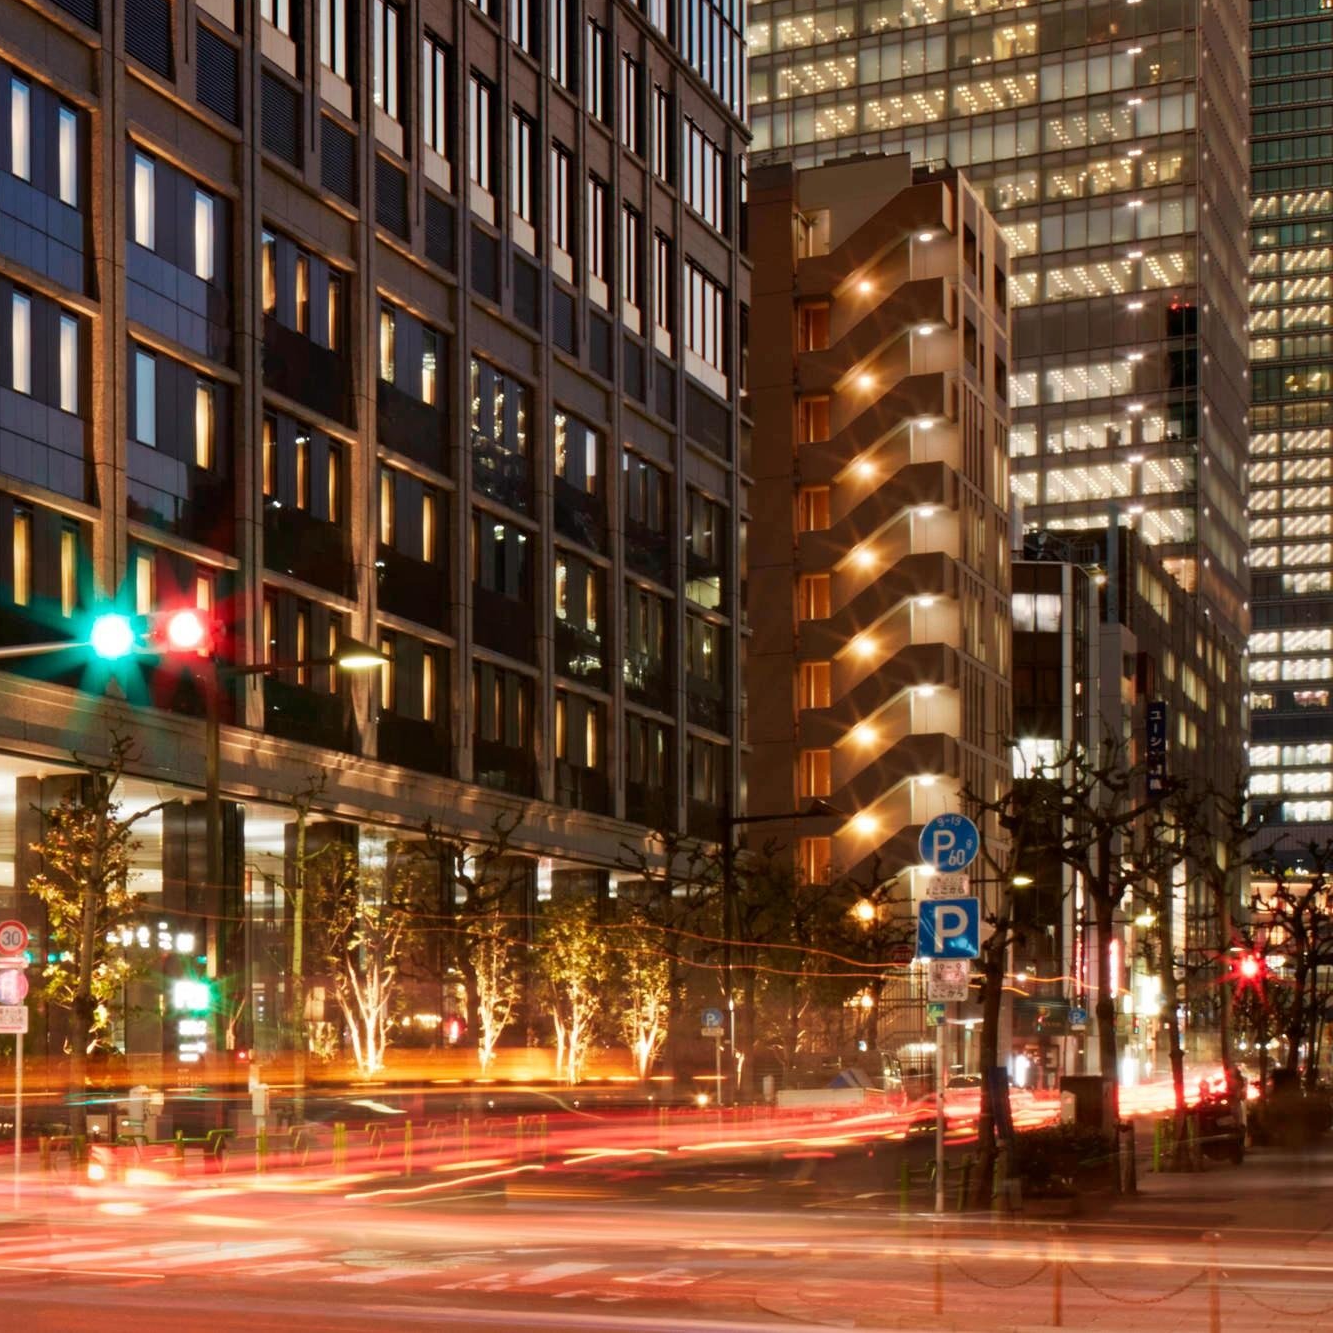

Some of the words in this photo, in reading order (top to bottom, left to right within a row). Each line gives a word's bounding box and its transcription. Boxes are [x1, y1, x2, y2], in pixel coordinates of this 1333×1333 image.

[933, 829, 956, 872] P
[948, 849, 966, 866] 60
[1, 930, 22, 946] 30
[934, 905, 969, 953] P
